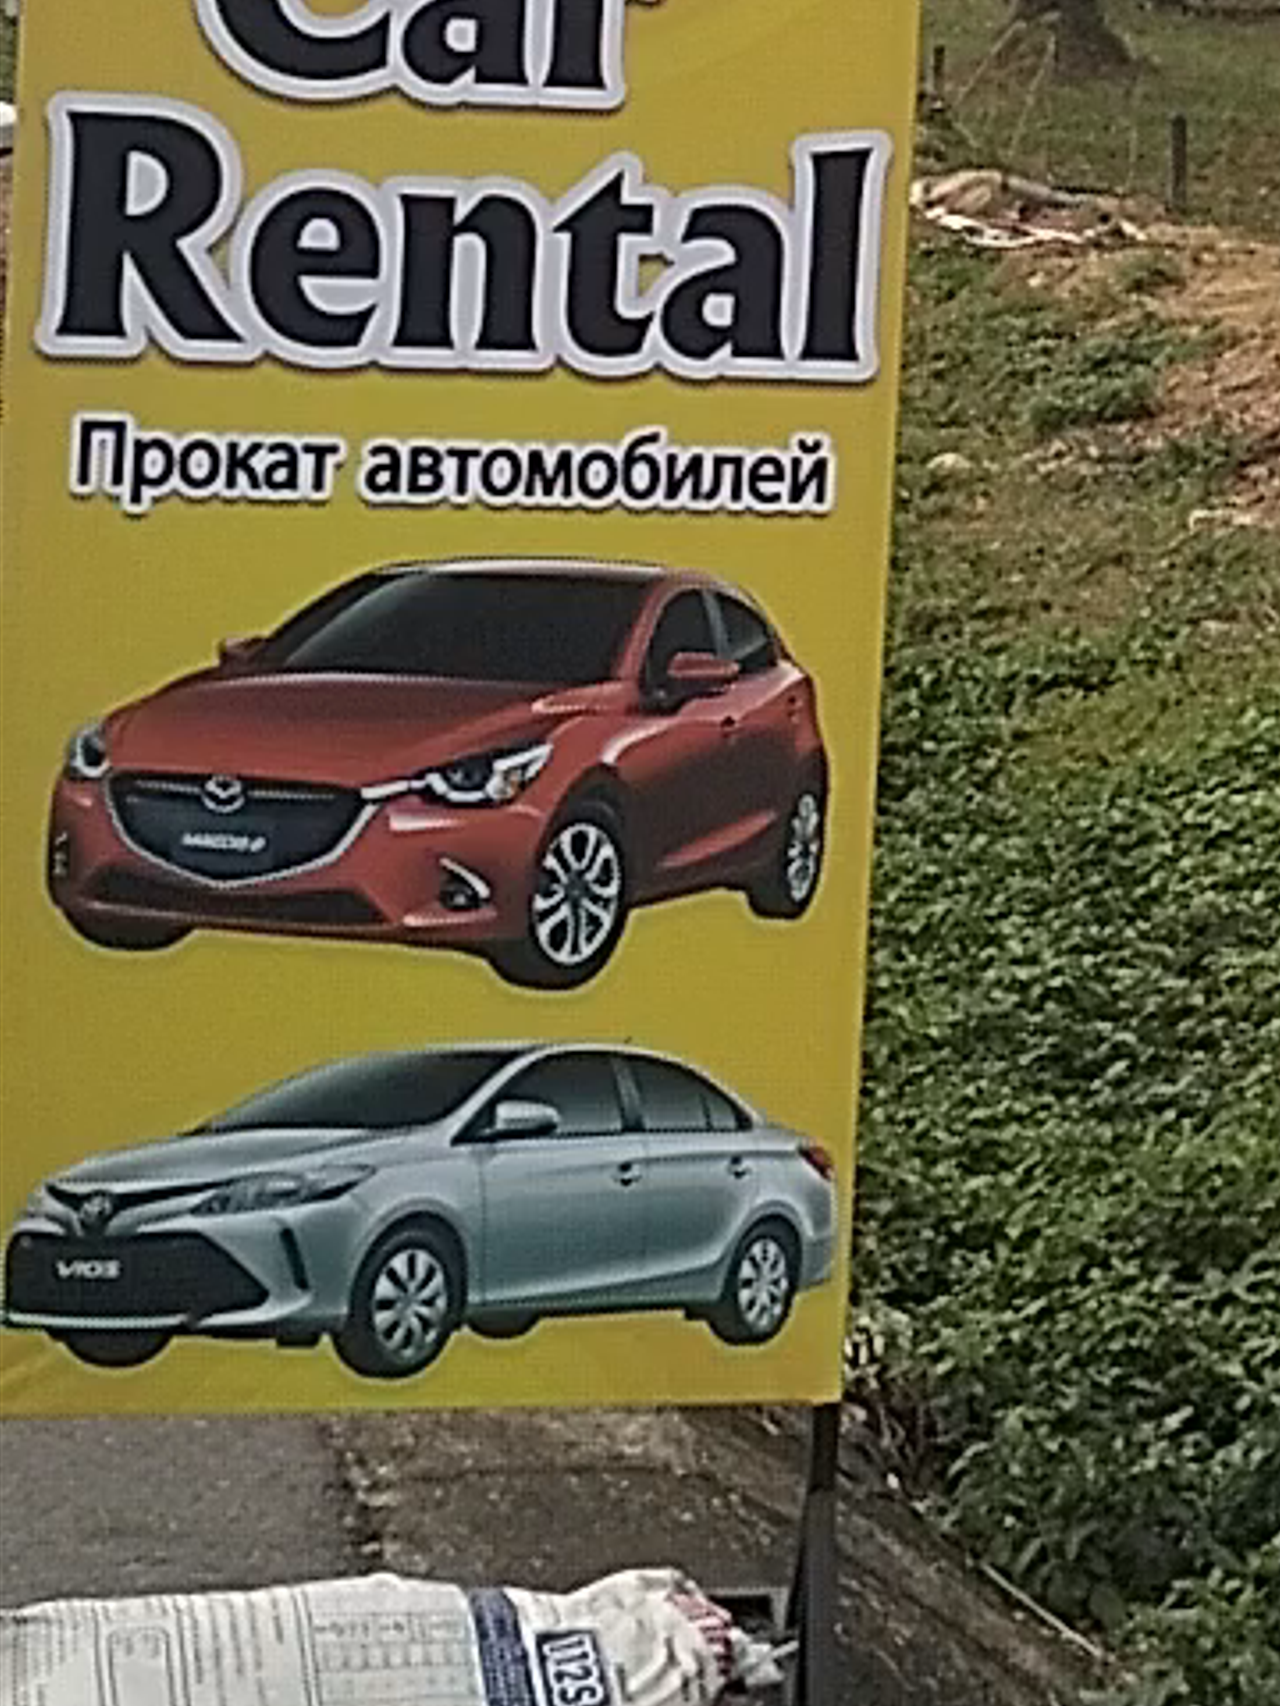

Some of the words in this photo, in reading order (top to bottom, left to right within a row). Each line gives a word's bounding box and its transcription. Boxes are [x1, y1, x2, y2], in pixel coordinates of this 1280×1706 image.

[55, 108, 876, 366] Rental
[76, 419, 343, 505] Прокат
[365, 432, 831, 508] автомобилей
